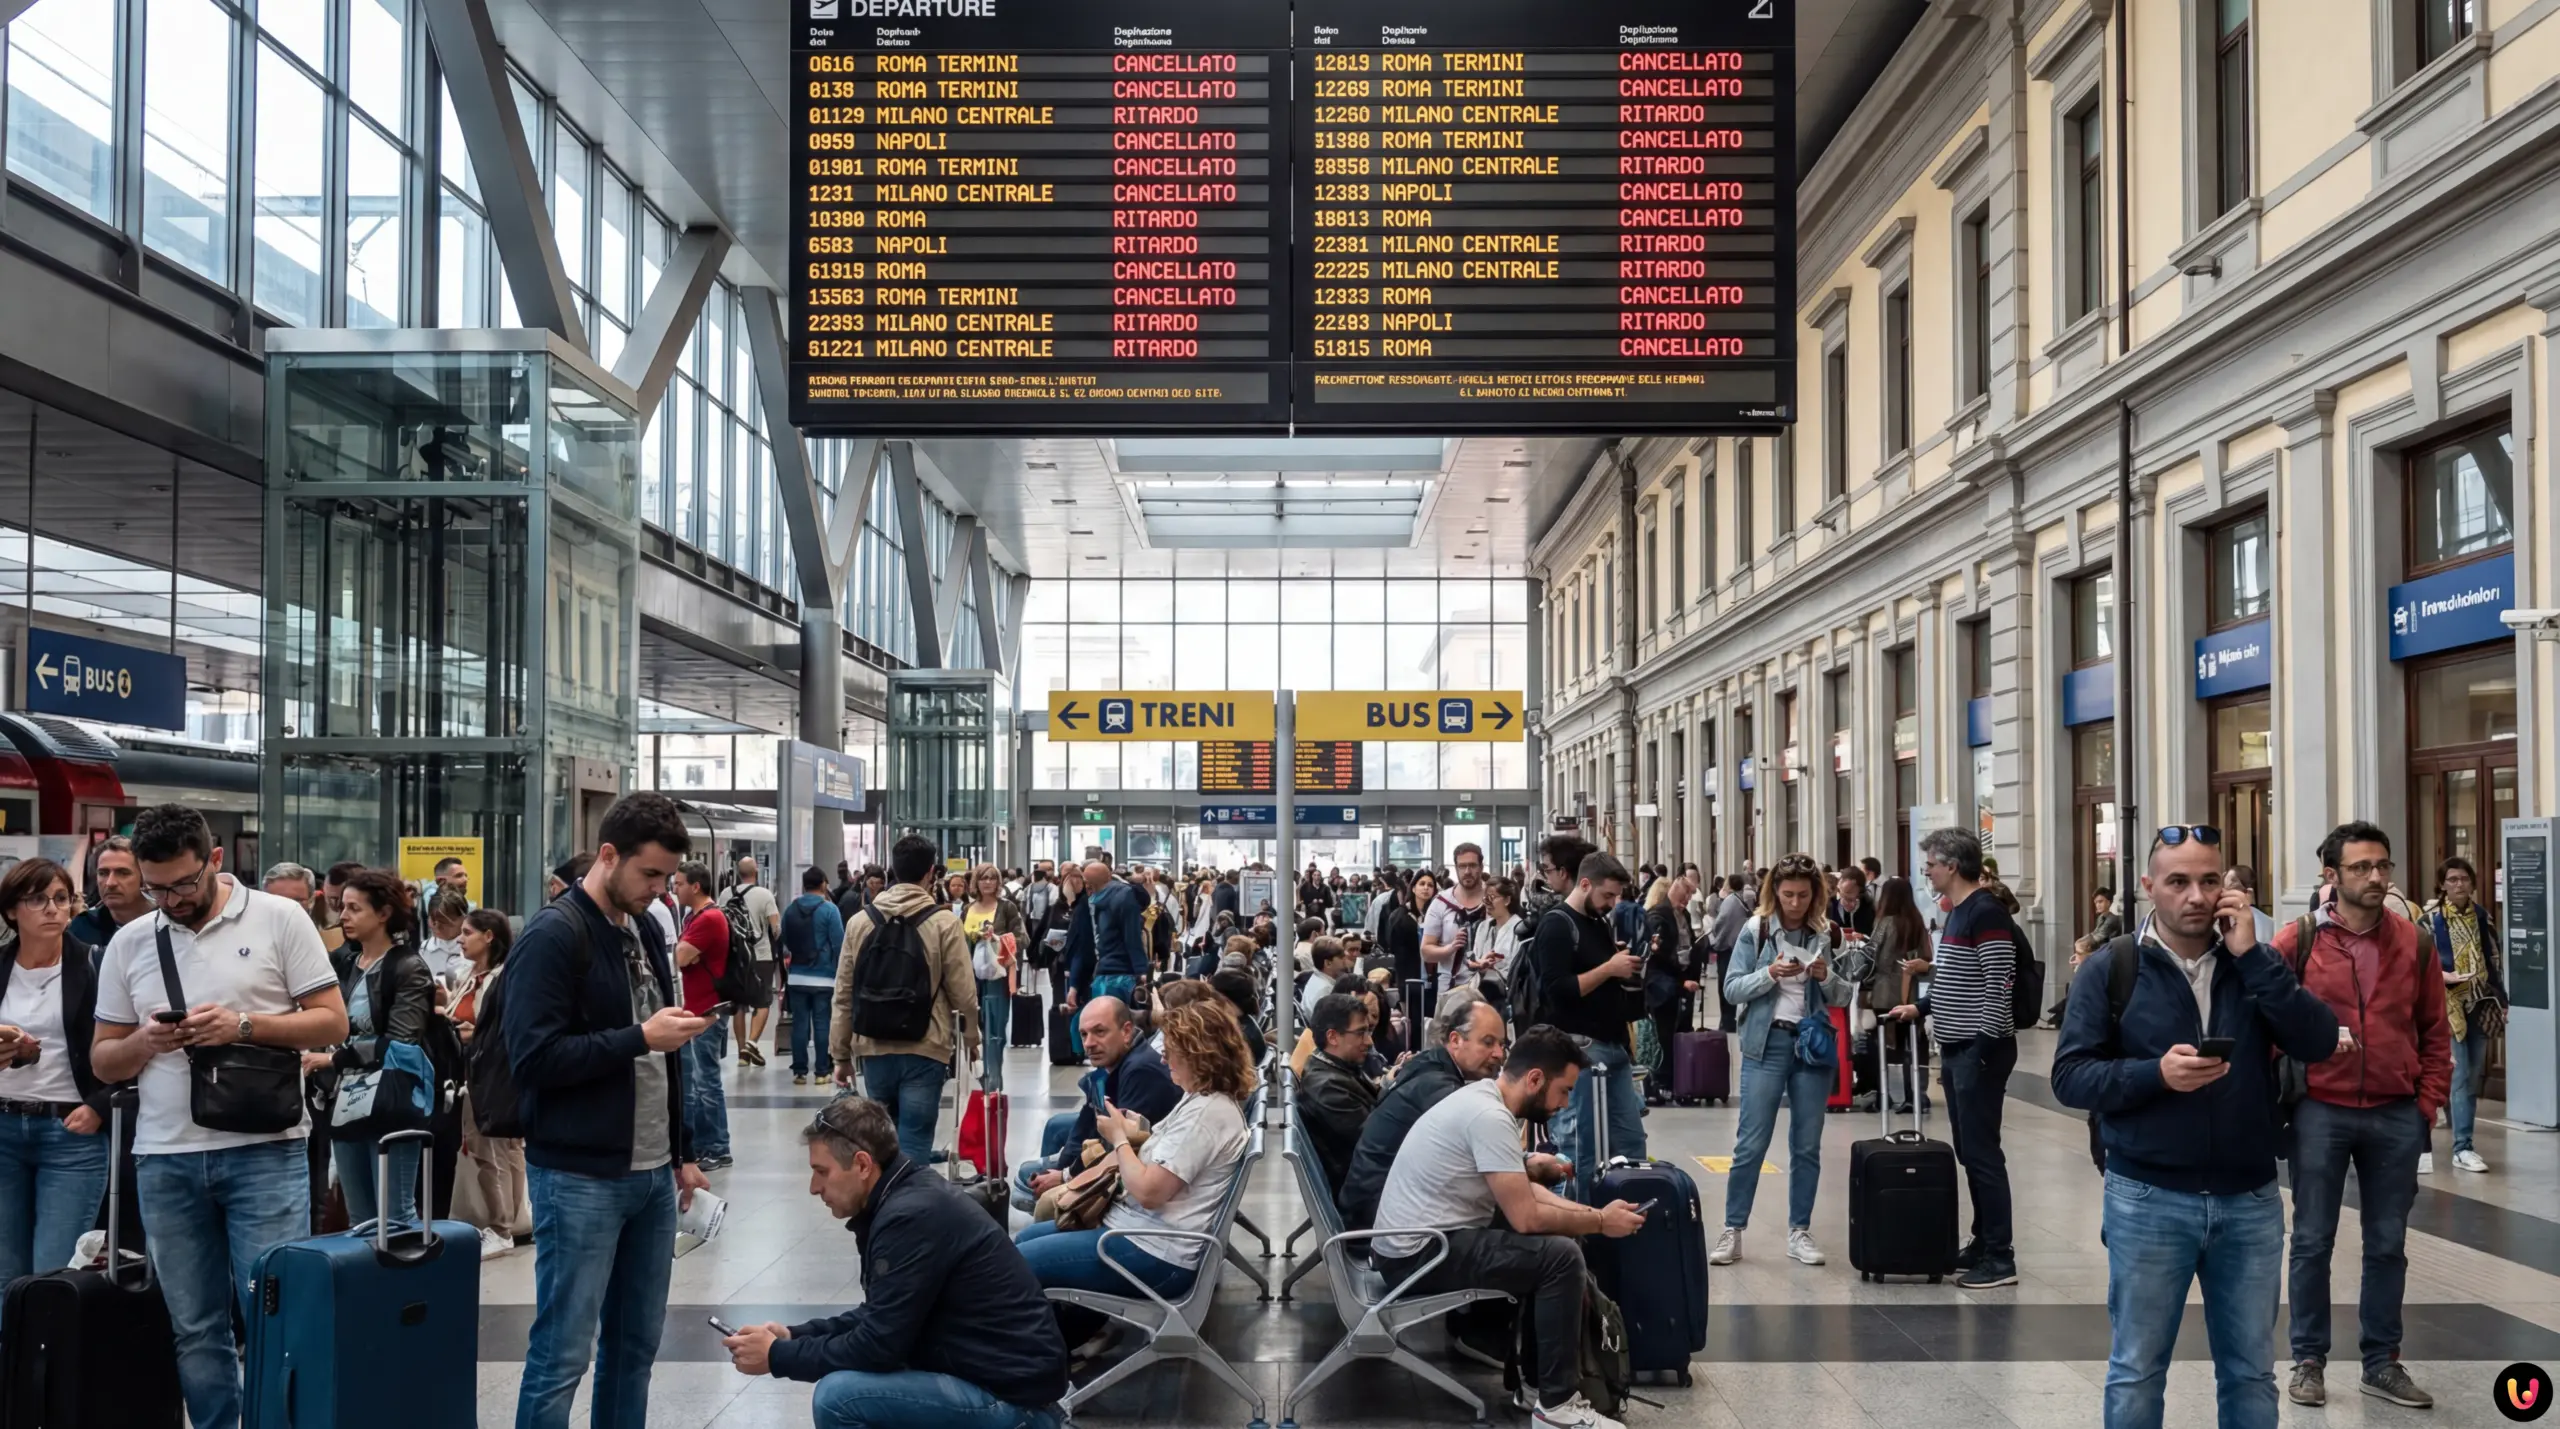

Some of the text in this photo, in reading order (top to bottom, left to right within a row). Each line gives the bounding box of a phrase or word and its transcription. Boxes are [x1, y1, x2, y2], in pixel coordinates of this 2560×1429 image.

[851, 0, 996, 17] DEPARTURE
[876, 54, 927, 73] ROMA
[937, 54, 1018, 73] TERMINI
[1113, 54, 1235, 73] CANCELLATO
[1381, 52, 1433, 72] ROMA
[1442, 52, 1524, 72] TERMINI
[1619, 52, 1743, 72] CANCELLATO
[876, 80, 927, 99] ROMA
[937, 80, 1018, 99] TERMINI
[1113, 80, 1235, 99] CANCELLATO
[1315, 78, 1743, 98] 12269 ROMA TERMINI CANCELLATO
[876, 106, 948, 125] MILANO
[956, 106, 1053, 125] CENTRALE
[1113, 106, 1198, 125] RITARDO
[1381, 104, 1454, 124] MILANO
[1462, 104, 1559, 124] CENTRALE
[1619, 104, 1705, 124] RITARDO
[876, 131, 947, 150] NAPOLI
[1113, 131, 1235, 150] CANCELLATO
[1381, 130, 1433, 149] ROMA
[1442, 130, 1524, 149] TERMINI
[1619, 130, 1743, 149] CANCELLATO
[876, 157, 927, 176] ROMA
[937, 157, 1018, 176] TERMINI
[1113, 157, 1235, 176] CANCELLATO
[1381, 156, 1454, 175] MILANO
[1462, 156, 1559, 175] CENTRALE
[1619, 156, 1705, 175] RITARDO
[809, 183, 1235, 203] 1231 MILANO CENTRALE CANCELLATO
[1315, 182, 1743, 202] 12383 NAPOLI CANCELLATO
[876, 209, 927, 228] ROMA
[1113, 209, 1198, 228] RITARDO
[1381, 208, 1433, 227] ROMA
[1619, 208, 1743, 227] CANCELLATO
[809, 236, 1198, 254] 6583 NAPOLI RITARDO
[1315, 234, 1705, 253] 22381 MILANO CENTRALE RITARDO
[876, 261, 927, 280] ROMA
[1113, 261, 1235, 280] CANCELLATO
[1315, 260, 1705, 279] 22225 MILANO CENTRALE RITARDO
[876, 287, 927, 306] ROMA
[937, 287, 1018, 306] TERMINI
[1113, 287, 1235, 306] CANCELLATO
[1381, 286, 1433, 305] ROMA
[1619, 286, 1743, 305] CANCELLATO
[876, 313, 948, 332] MILANO
[956, 313, 1053, 332] CENTRALE
[1113, 313, 1198, 332] RITARDO
[1381, 311, 1452, 331] NAPOLI
[1619, 311, 1705, 331] RITARDO
[876, 339, 948, 357] MILANO
[956, 339, 1053, 357] CENTRALE
[1113, 339, 1198, 357] RITARDO
[1315, 337, 1743, 357] 51815 ROMA CANCELLATO
[85, 666, 115, 693] BUS
[1141, 702, 1234, 728] TRENI
[1366, 702, 1431, 728] BUS
